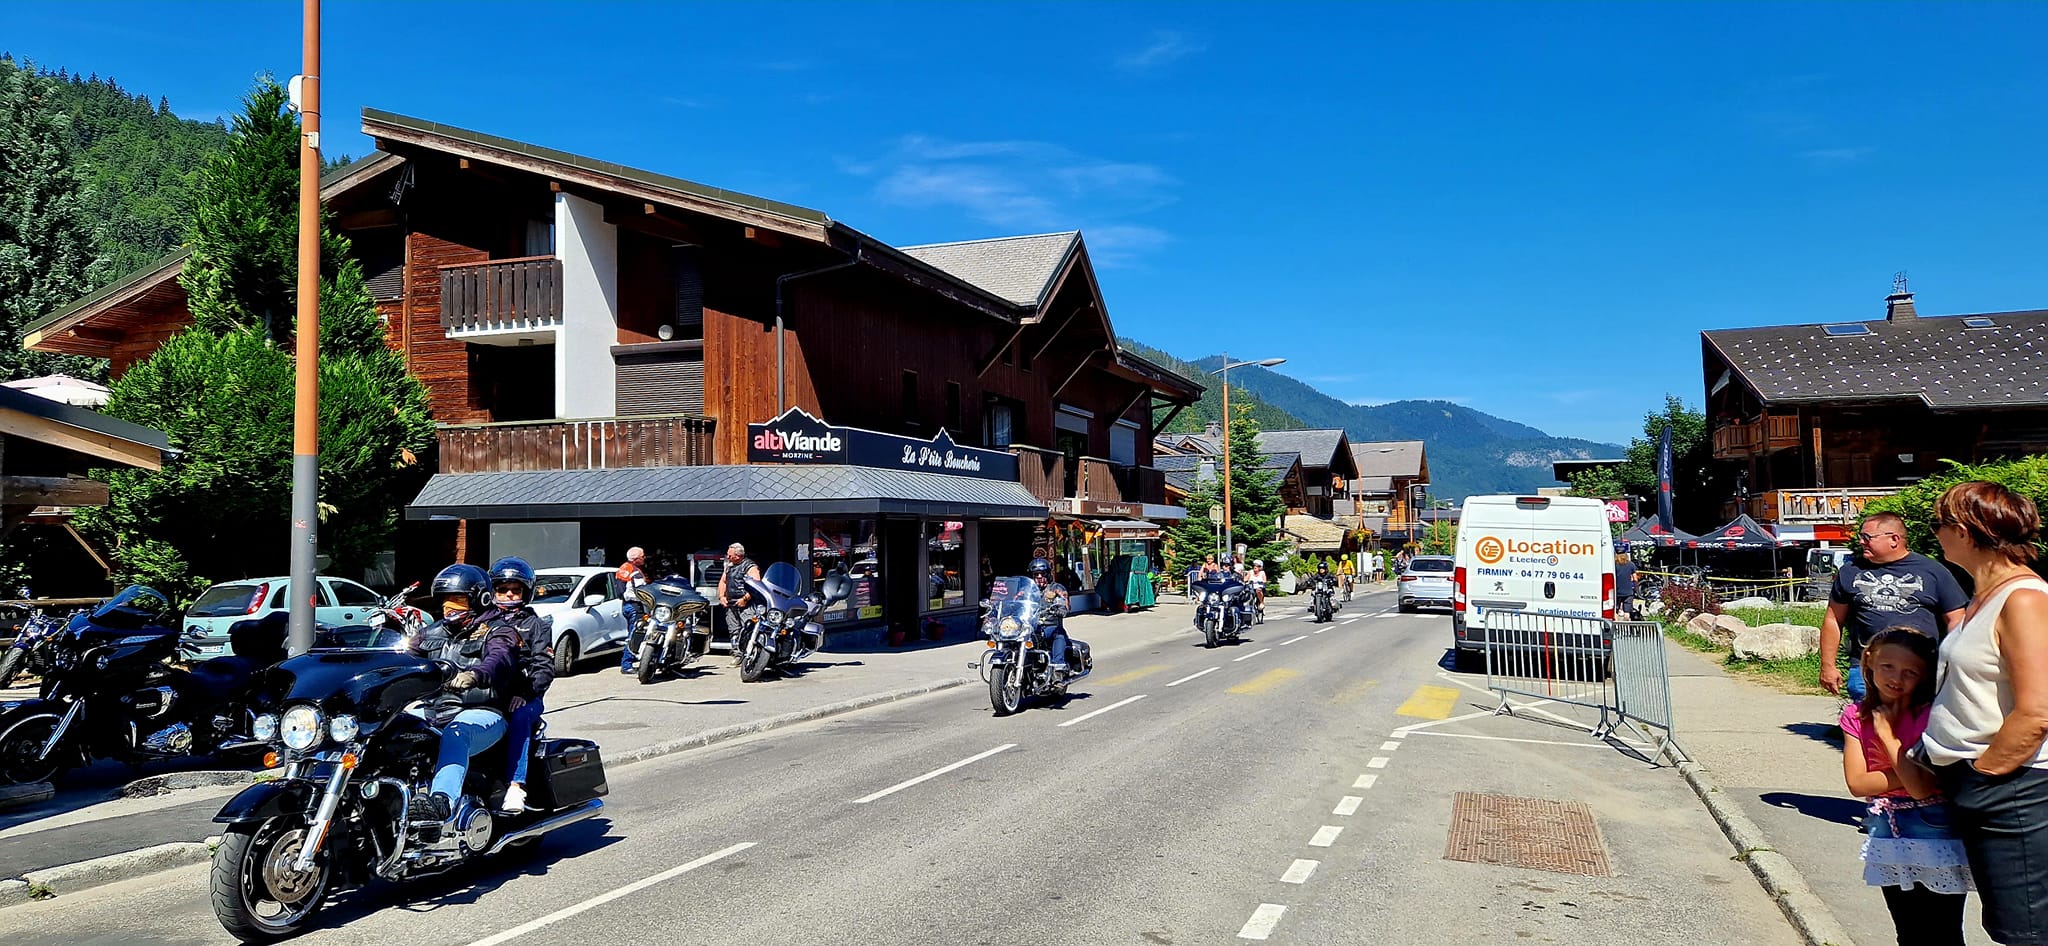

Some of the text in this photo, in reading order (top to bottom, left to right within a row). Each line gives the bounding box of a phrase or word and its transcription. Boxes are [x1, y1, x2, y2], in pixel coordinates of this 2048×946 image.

[754, 429, 841, 452] altiViande
[902, 445, 916, 464] La
[944, 450, 981, 472] Boucherie
[1508, 539, 1594, 555] Location
[1510, 556, 1546, 564] E.Leclerc
[1478, 568, 1513, 576] FIRMINY
[1521, 569, 1532, 577] 04
[1534, 570, 1544, 578] 77
[1547, 571, 1557, 579] 79
[1560, 571, 1570, 579] 06
[1573, 572, 1584, 580] 44
